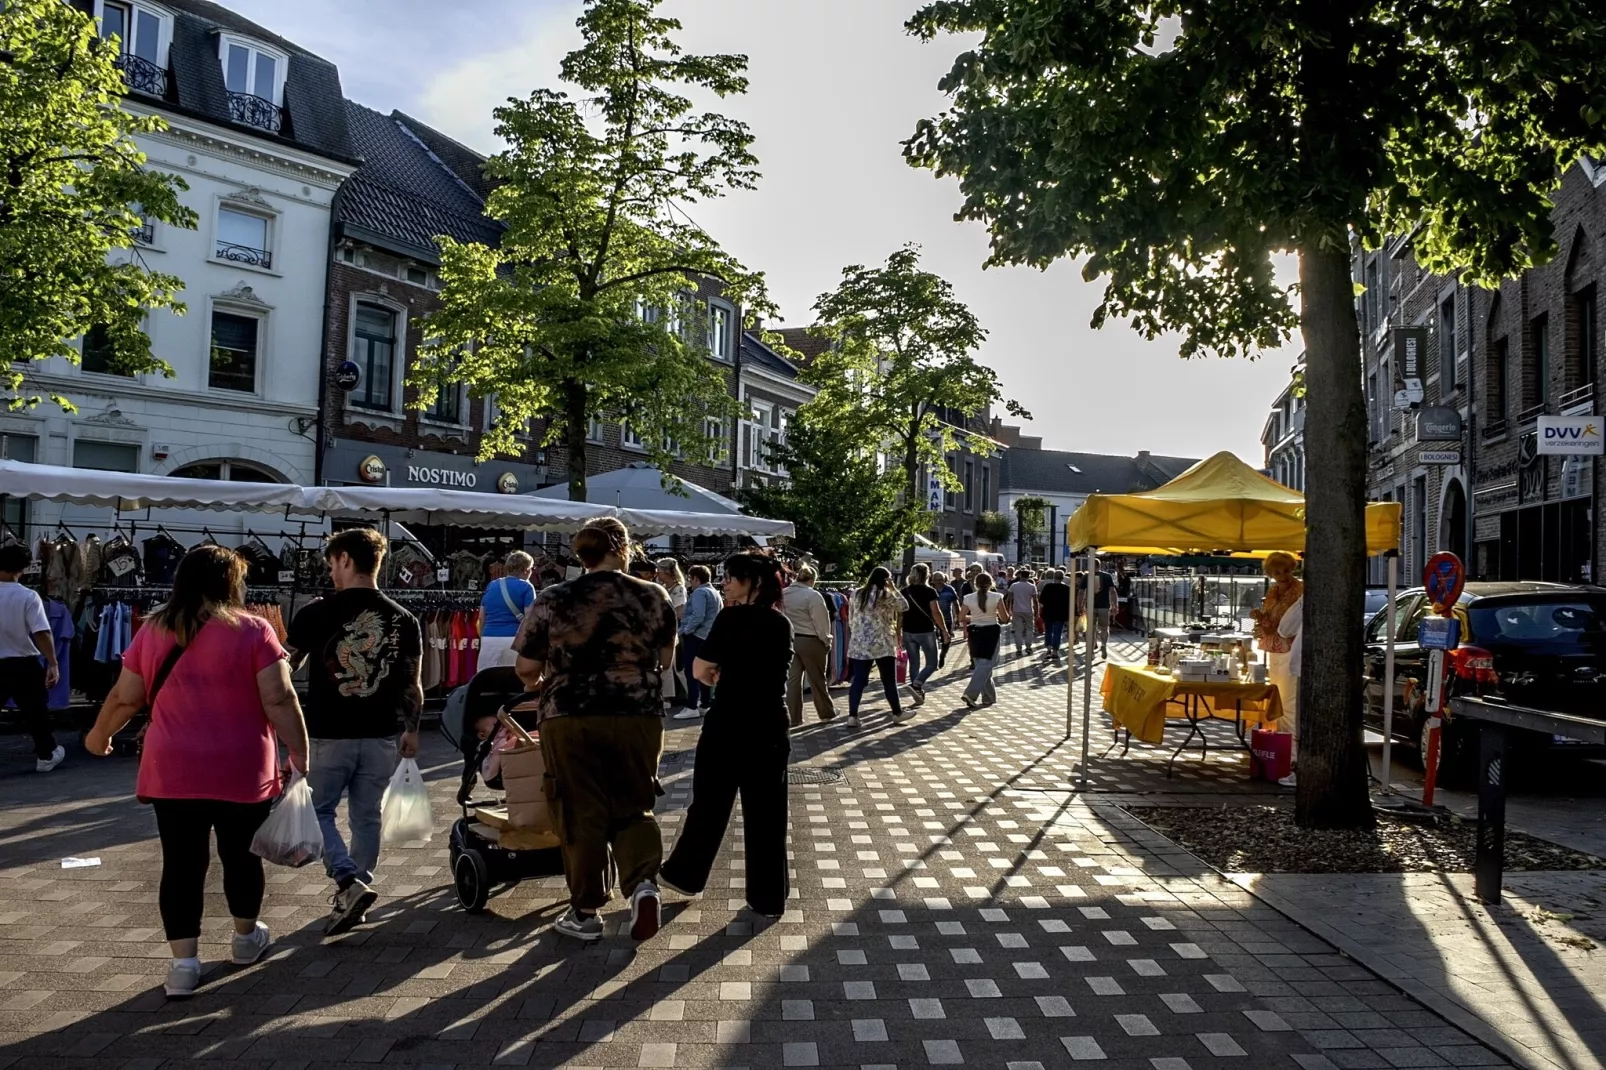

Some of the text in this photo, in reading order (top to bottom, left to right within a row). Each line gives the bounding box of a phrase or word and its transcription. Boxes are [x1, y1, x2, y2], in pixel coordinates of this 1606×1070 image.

[1544, 427, 1581, 439] DVV
[366, 464, 385, 474] Cristal
[408, 465, 477, 488] NOSTIMO
